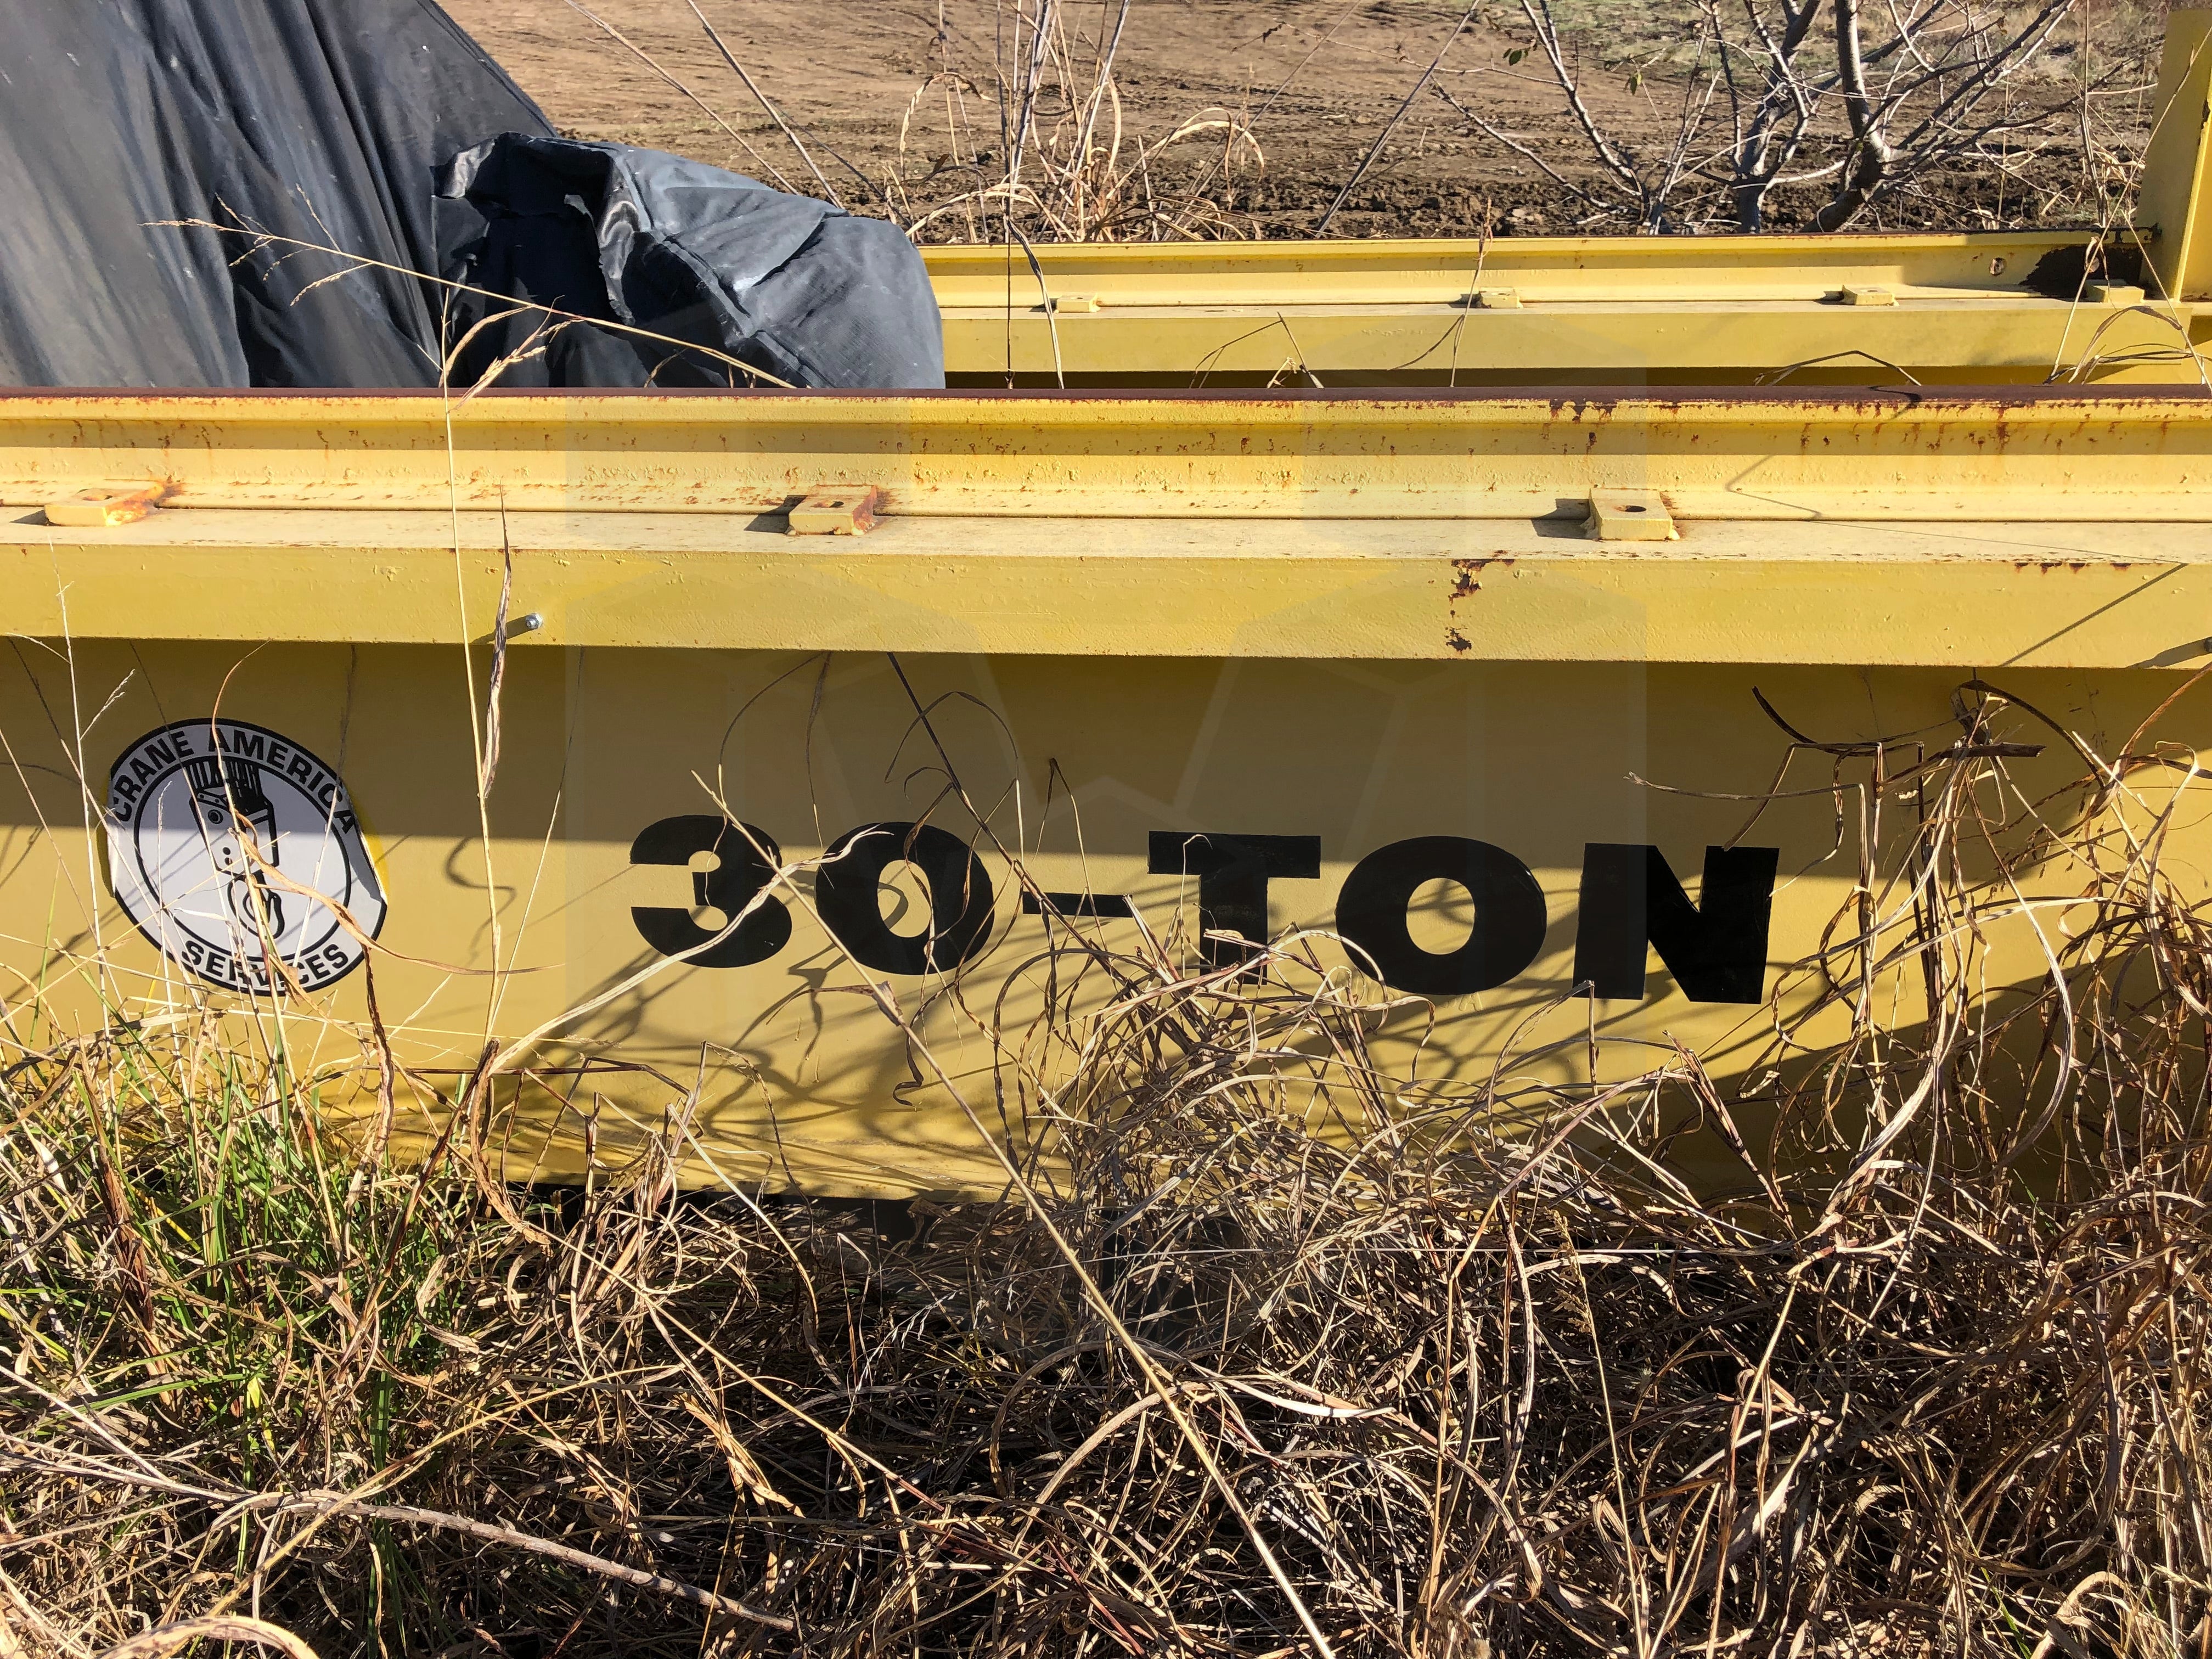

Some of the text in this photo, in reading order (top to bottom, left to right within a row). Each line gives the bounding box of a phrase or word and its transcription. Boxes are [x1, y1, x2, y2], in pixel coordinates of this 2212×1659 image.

[112, 727, 356, 834] CRANE AMERICA
[629, 814, 1780, 1005] 30-TON
